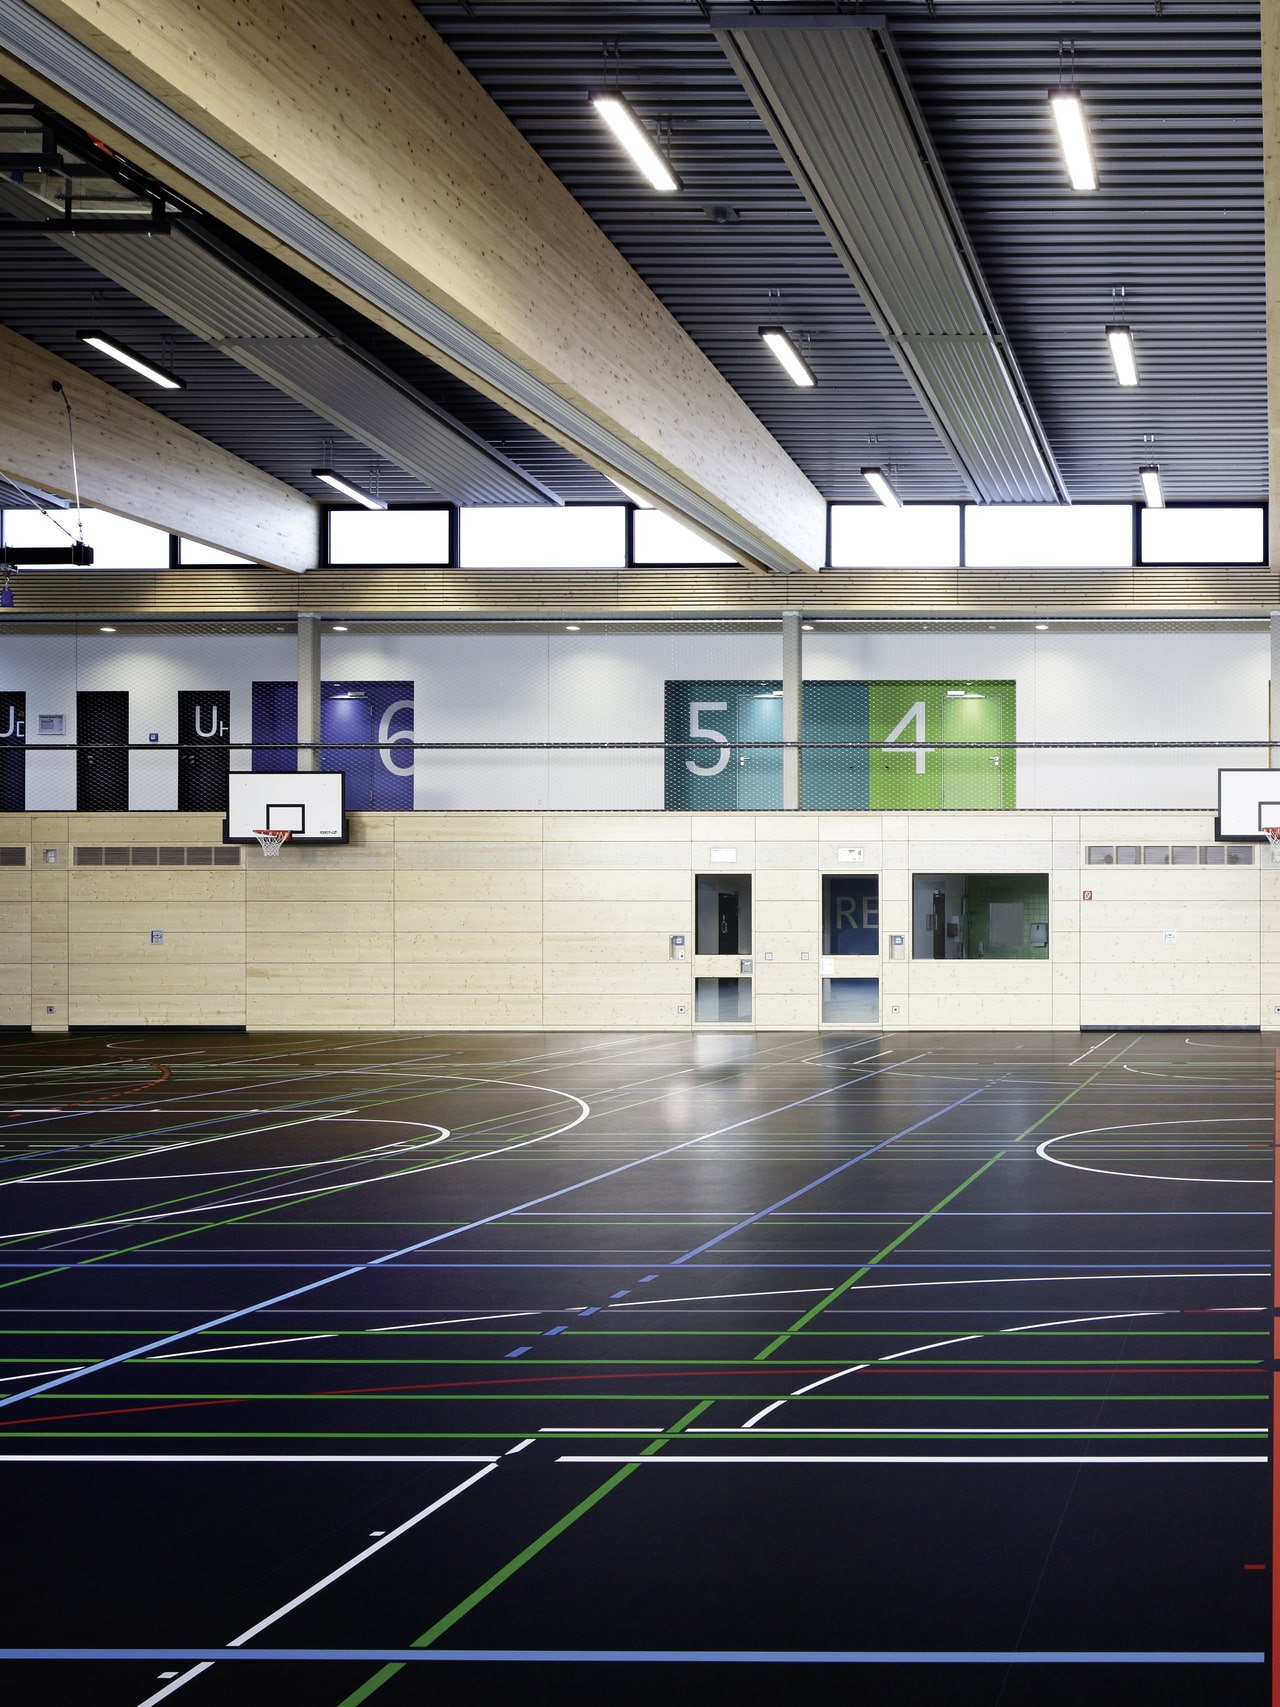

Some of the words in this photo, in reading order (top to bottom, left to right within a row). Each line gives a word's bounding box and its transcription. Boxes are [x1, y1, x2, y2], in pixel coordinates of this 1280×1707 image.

[379, 699, 414, 777] 6
[685, 701, 731, 776] 5
[881, 701, 936, 774] 4
